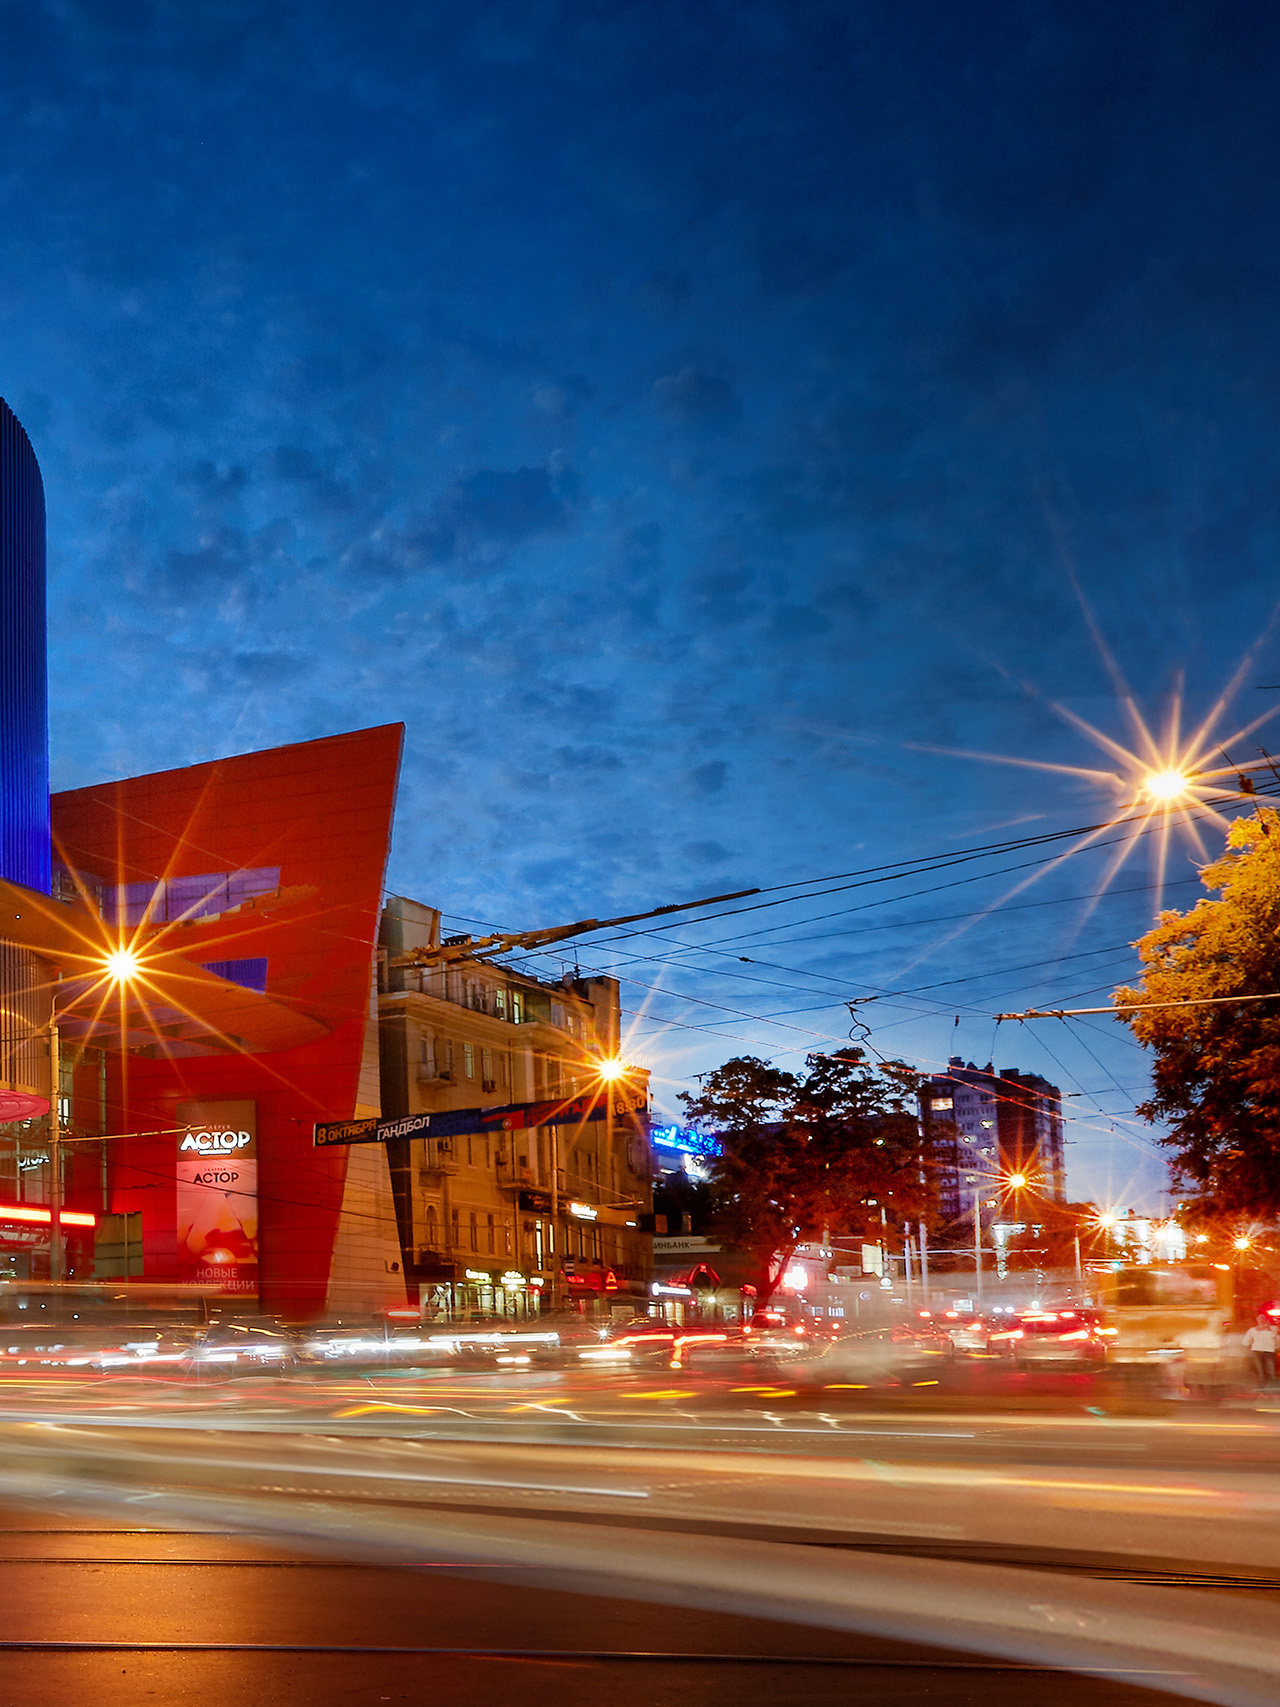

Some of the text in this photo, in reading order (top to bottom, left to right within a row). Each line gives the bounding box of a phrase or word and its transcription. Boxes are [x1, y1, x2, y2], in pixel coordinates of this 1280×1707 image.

[317, 1128, 326, 1144] 8
[327, 1119, 377, 1141] ОКТЯБРЯ
[376, 1115, 431, 1141] ГАНДБОЛ
[180, 1131, 252, 1151] АСТОР
[193, 1172, 239, 1184] АСТОР
[196, 1267, 238, 1279] НОВЫЕ
